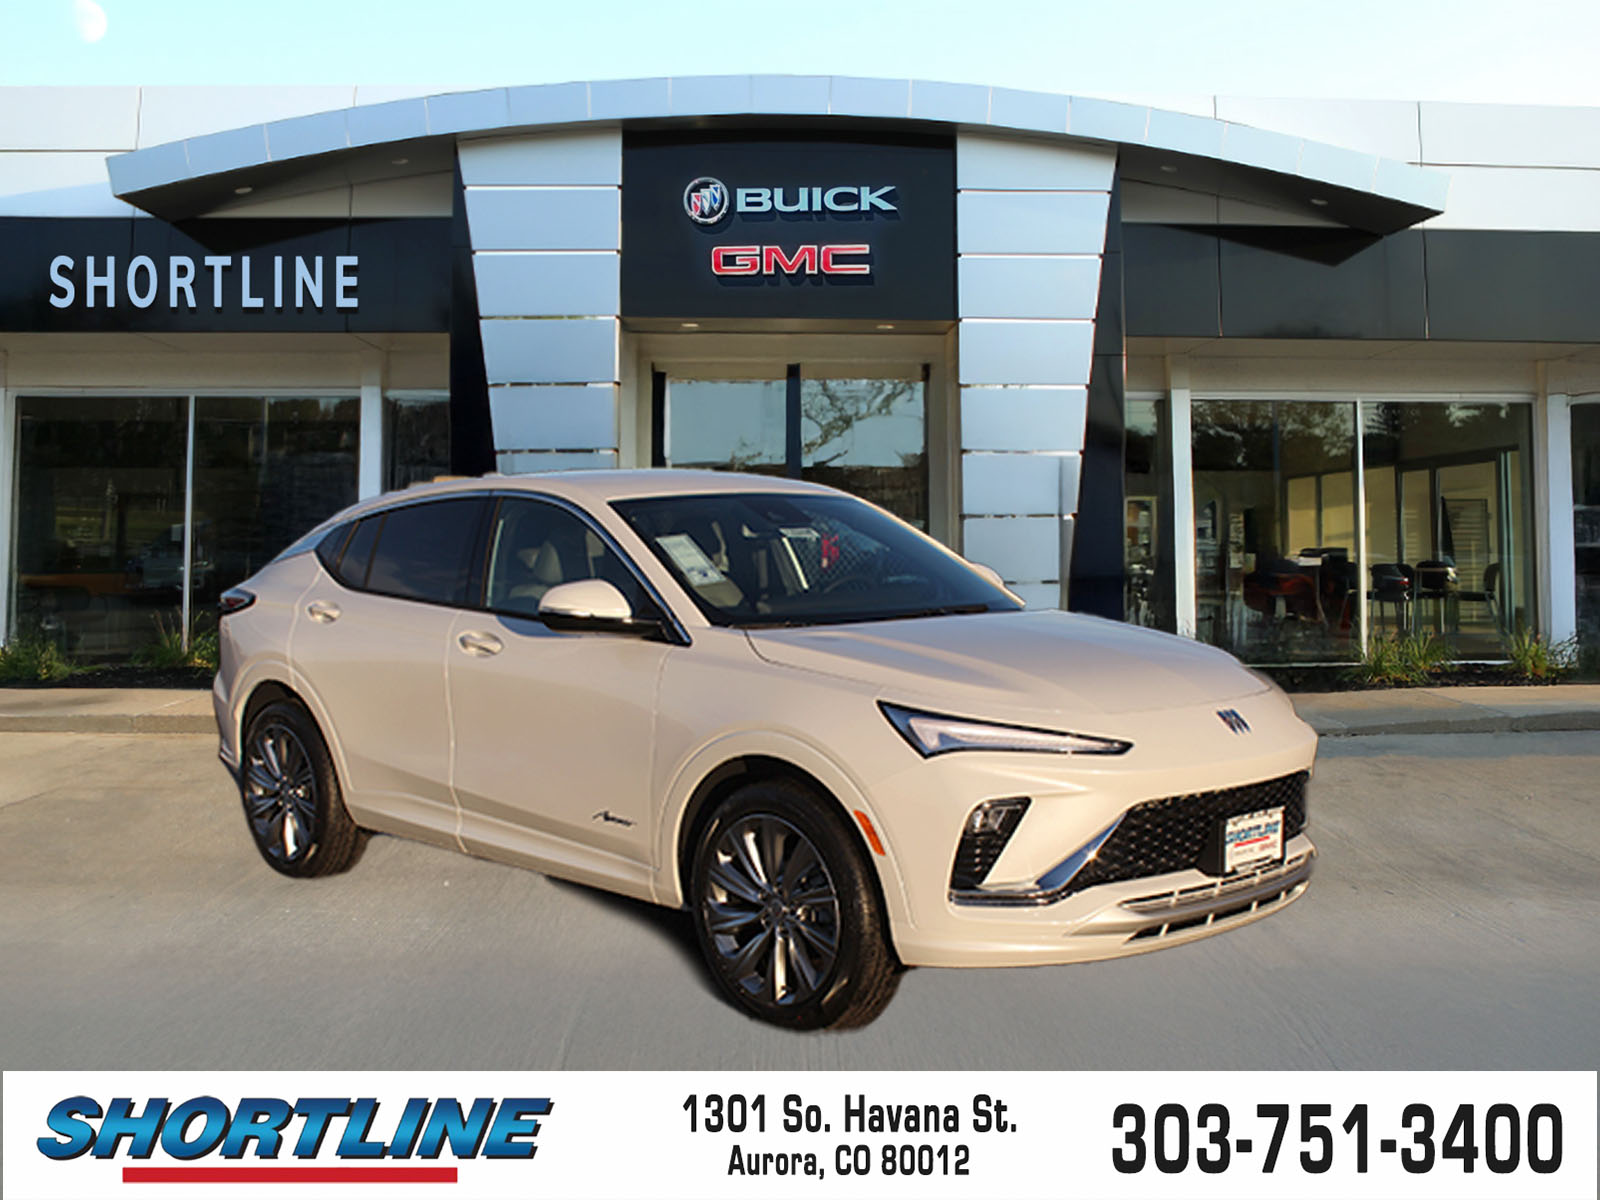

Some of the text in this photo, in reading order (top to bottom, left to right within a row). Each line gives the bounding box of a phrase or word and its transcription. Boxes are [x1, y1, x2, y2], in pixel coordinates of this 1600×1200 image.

[736, 186, 898, 212] BUICK
[711, 244, 870, 275] GMC
[49, 255, 359, 308] SHORTLINE
